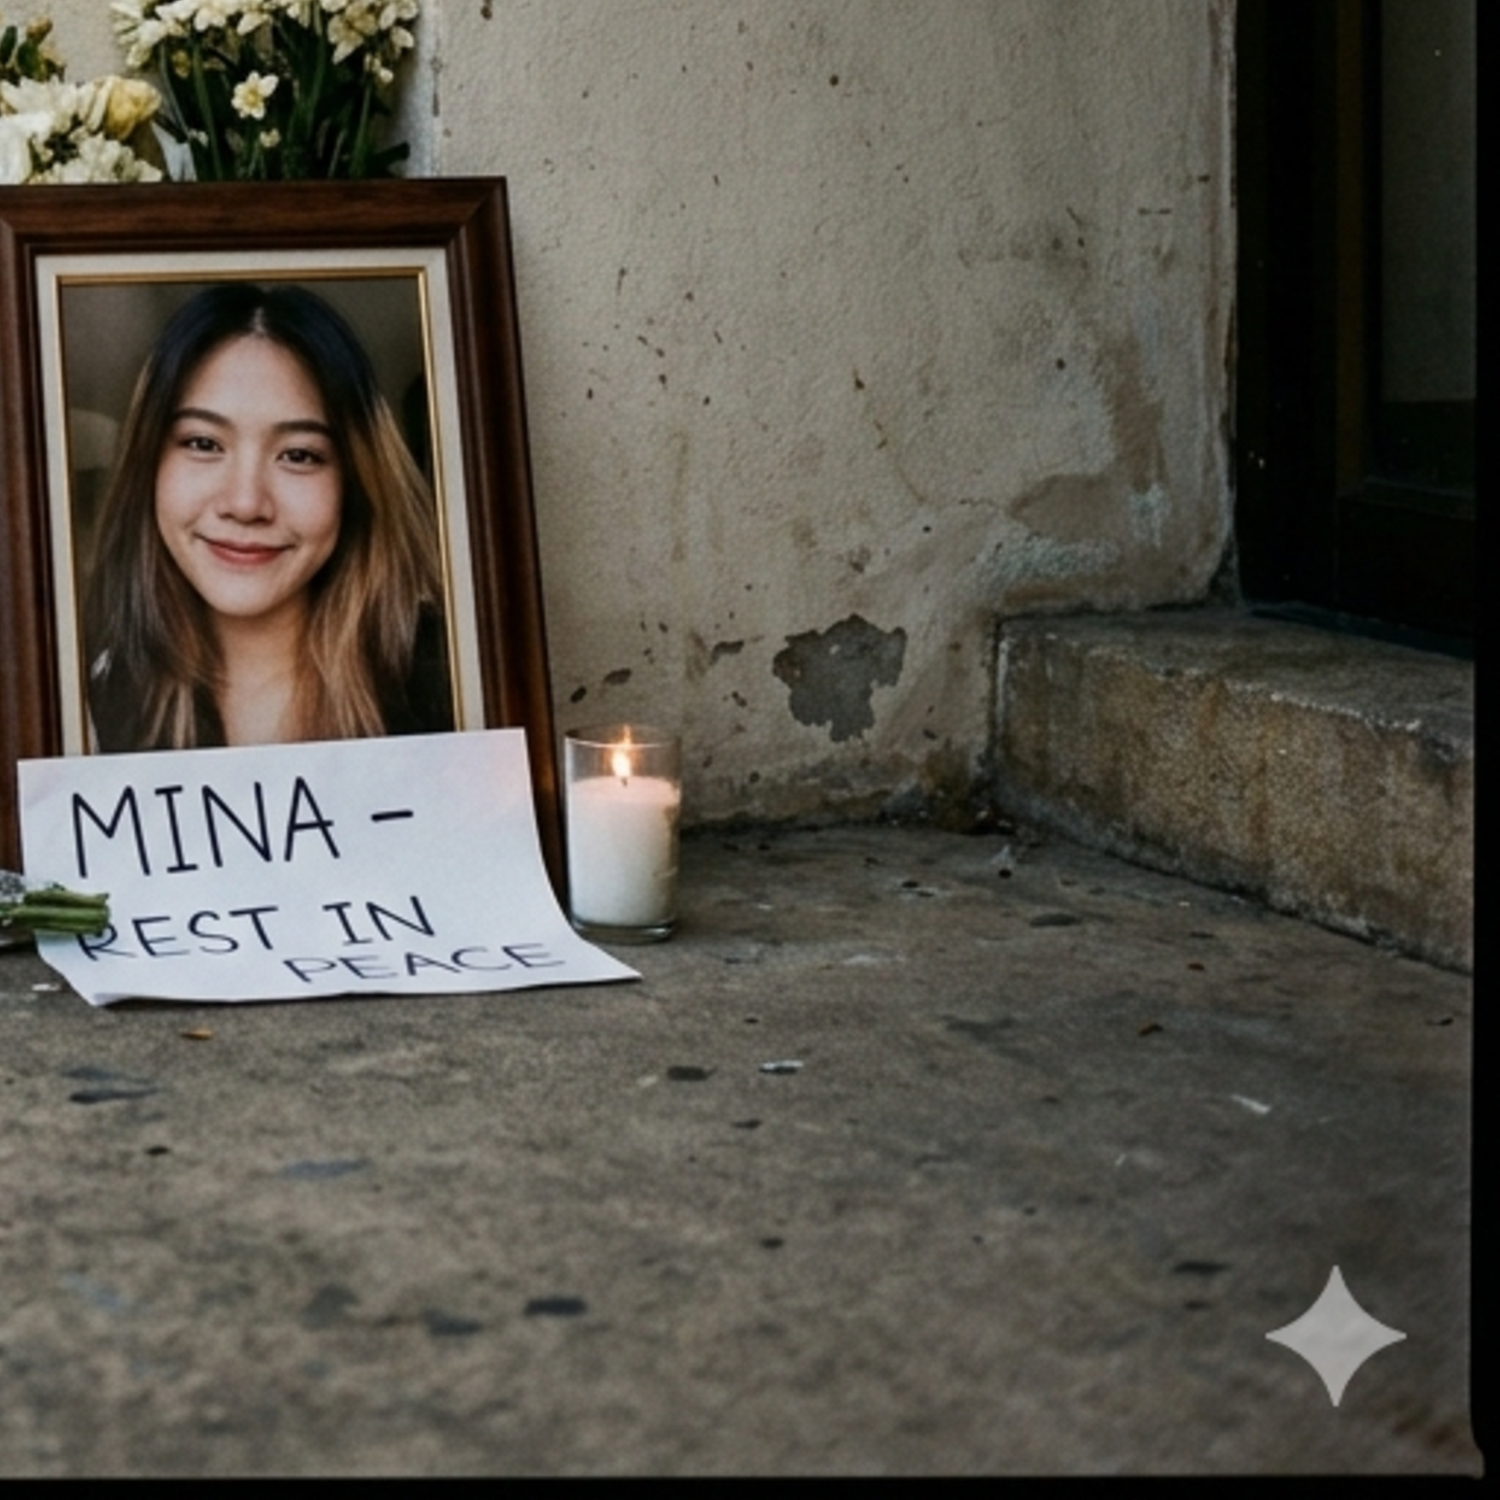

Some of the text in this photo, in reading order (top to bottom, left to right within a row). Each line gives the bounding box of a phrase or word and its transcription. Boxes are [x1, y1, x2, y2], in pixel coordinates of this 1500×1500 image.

[71, 776, 341, 879] MINA
[323, 895, 436, 946] IN
[283, 943, 566, 983] PEACE
